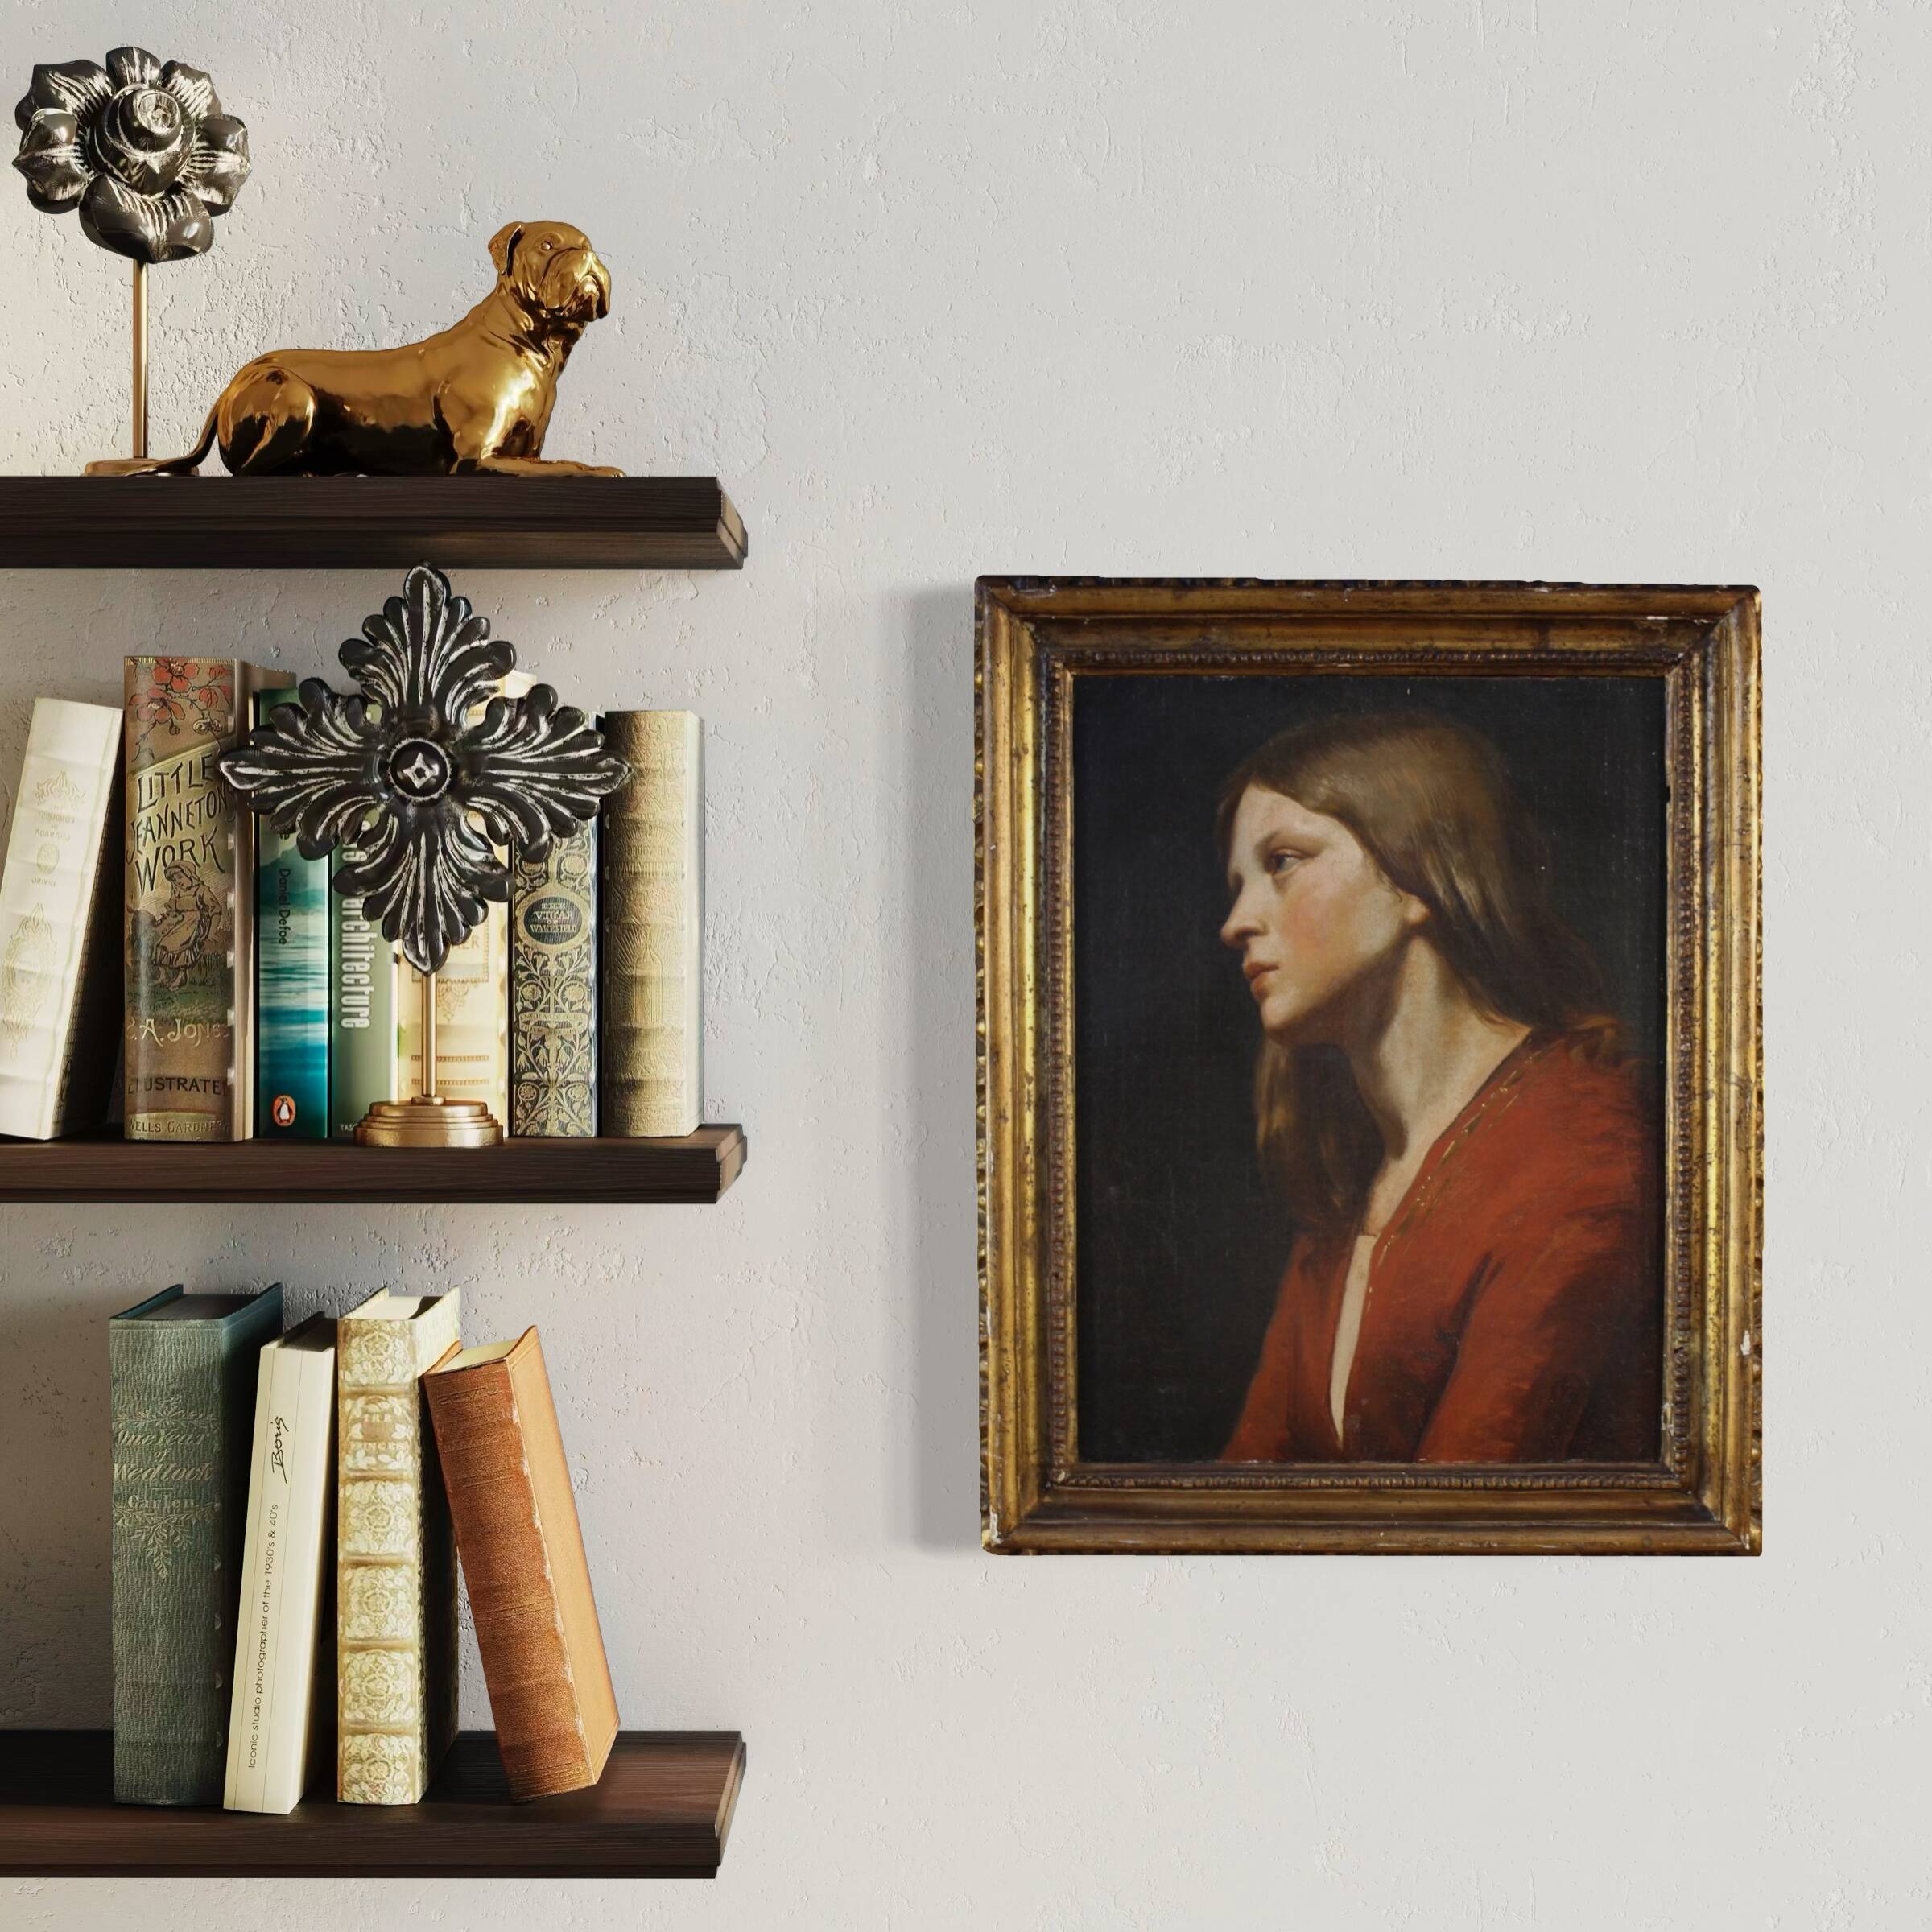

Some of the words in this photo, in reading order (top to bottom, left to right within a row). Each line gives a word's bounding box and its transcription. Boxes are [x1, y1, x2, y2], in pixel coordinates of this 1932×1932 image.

[136, 753, 213, 813] LITTLE
[135, 825, 225, 897] WORK
[279, 869, 291, 912] Daniel
[279, 914, 291, 945] Defoe
[530, 924, 577, 933] WAKEFIELD
[341, 898, 378, 1029] architecture
[128, 1119, 162, 1133] WELLS
[270, 1416, 289, 1484] Boris
[113, 1461, 213, 1482] Wedlock
[269, 1504, 279, 1527] 40's
[267, 1530, 276, 1538] &
[264, 1541, 275, 1575] 1930's
[263, 1579, 271, 1598] the
[262, 1601, 270, 1613] of
[255, 1616, 268, 1695] photographer
[251, 1696, 262, 1732] studio
[248, 1733, 258, 1769] Iconic
